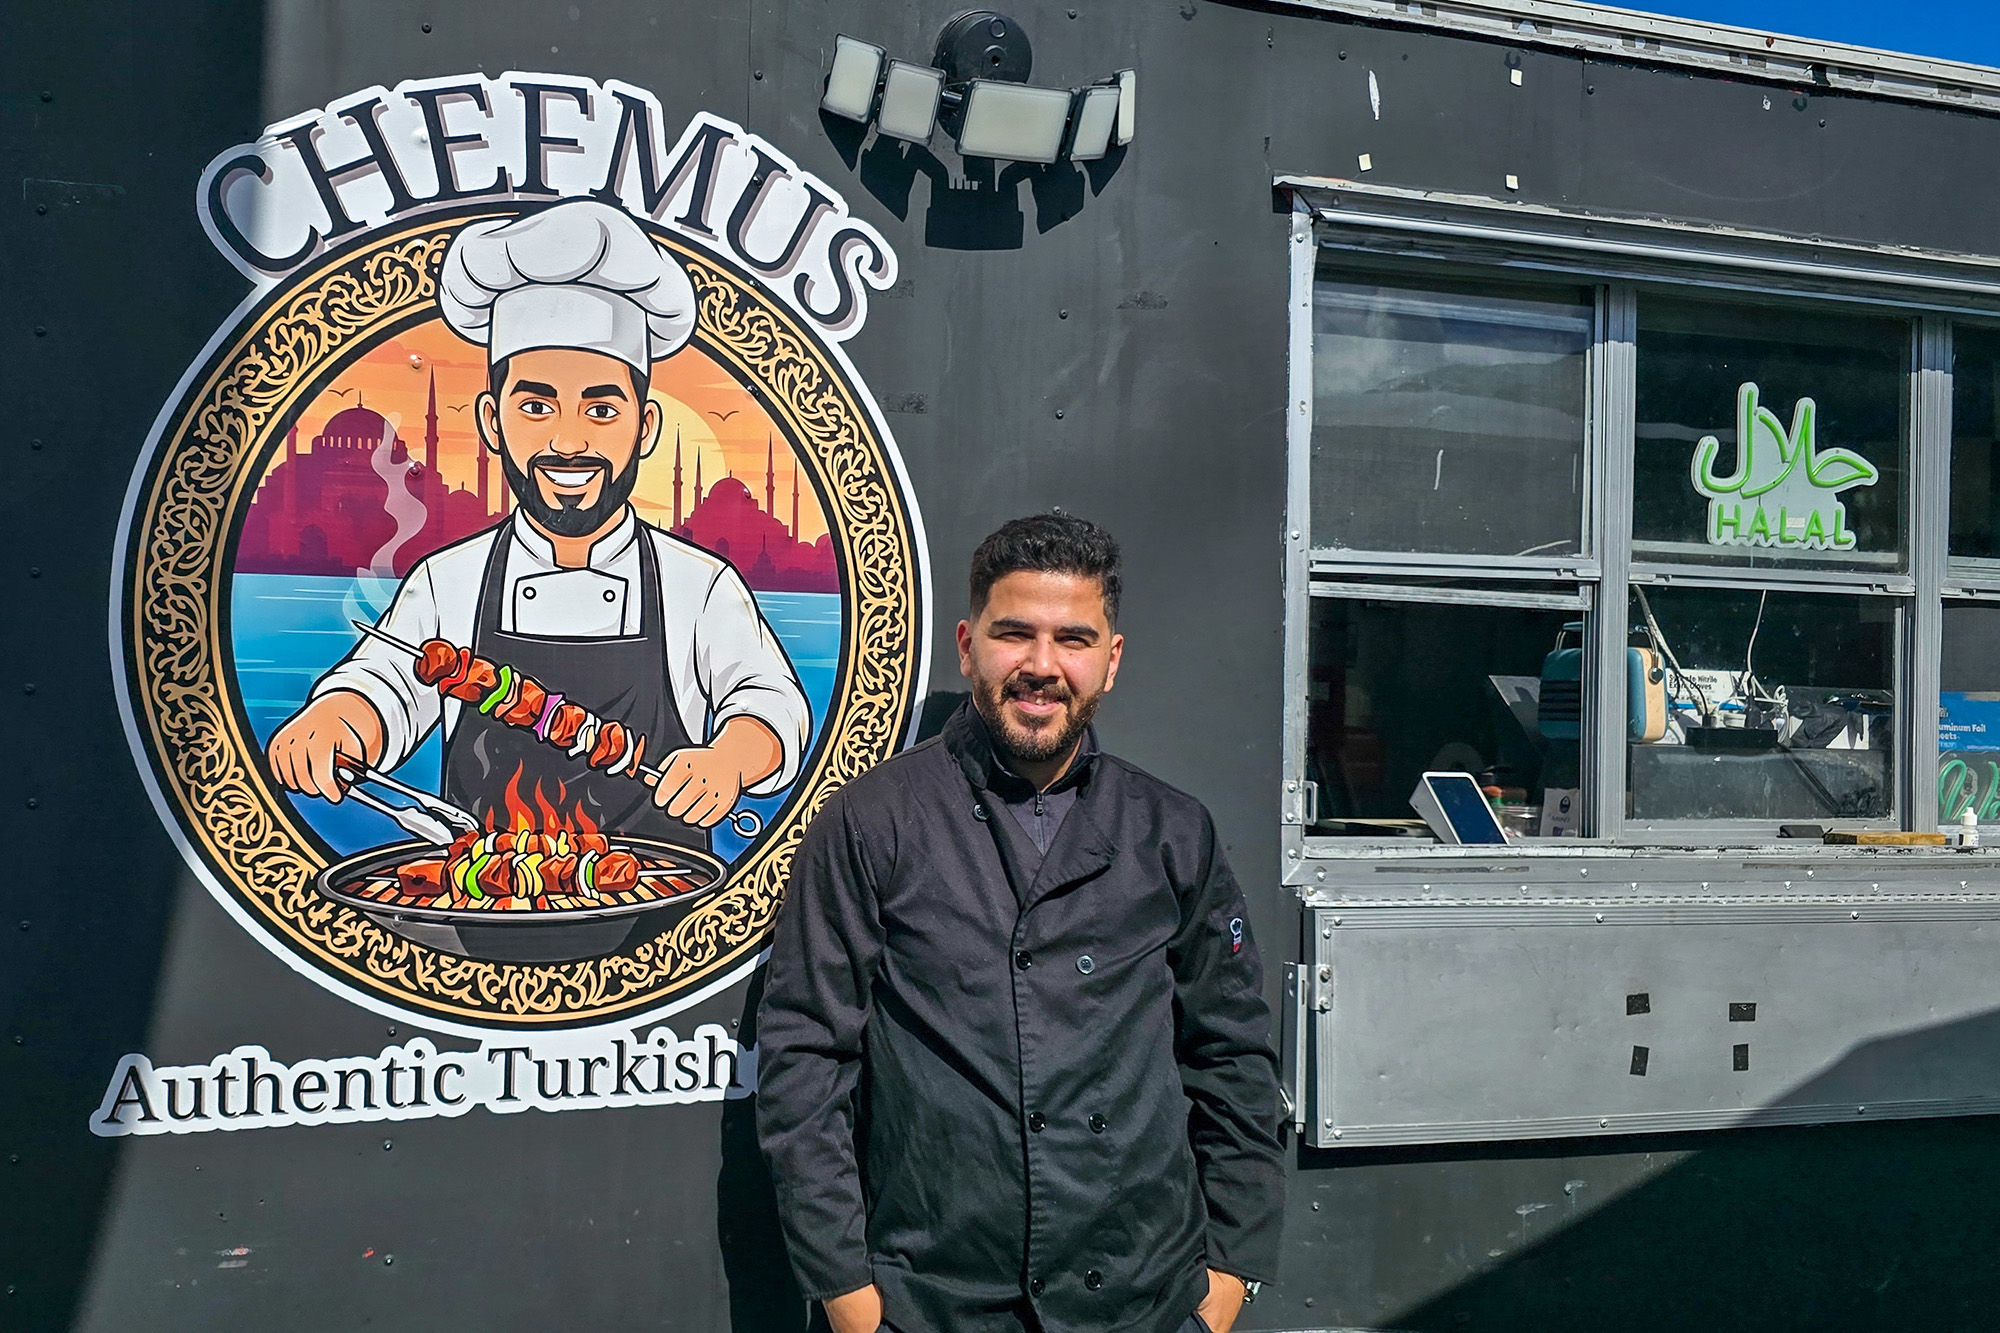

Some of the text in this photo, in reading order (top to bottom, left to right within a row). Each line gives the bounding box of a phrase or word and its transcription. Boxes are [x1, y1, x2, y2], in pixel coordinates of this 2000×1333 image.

[207, 81, 889, 324] CHEFMUS
[1700, 389, 1874, 499] حلال
[1716, 503, 1852, 544] HALAL
[1939, 722, 1987, 732] uminum Foil
[1939, 732, 1957, 740] eets
[103, 1035, 744, 1125] Authentic Turkish
